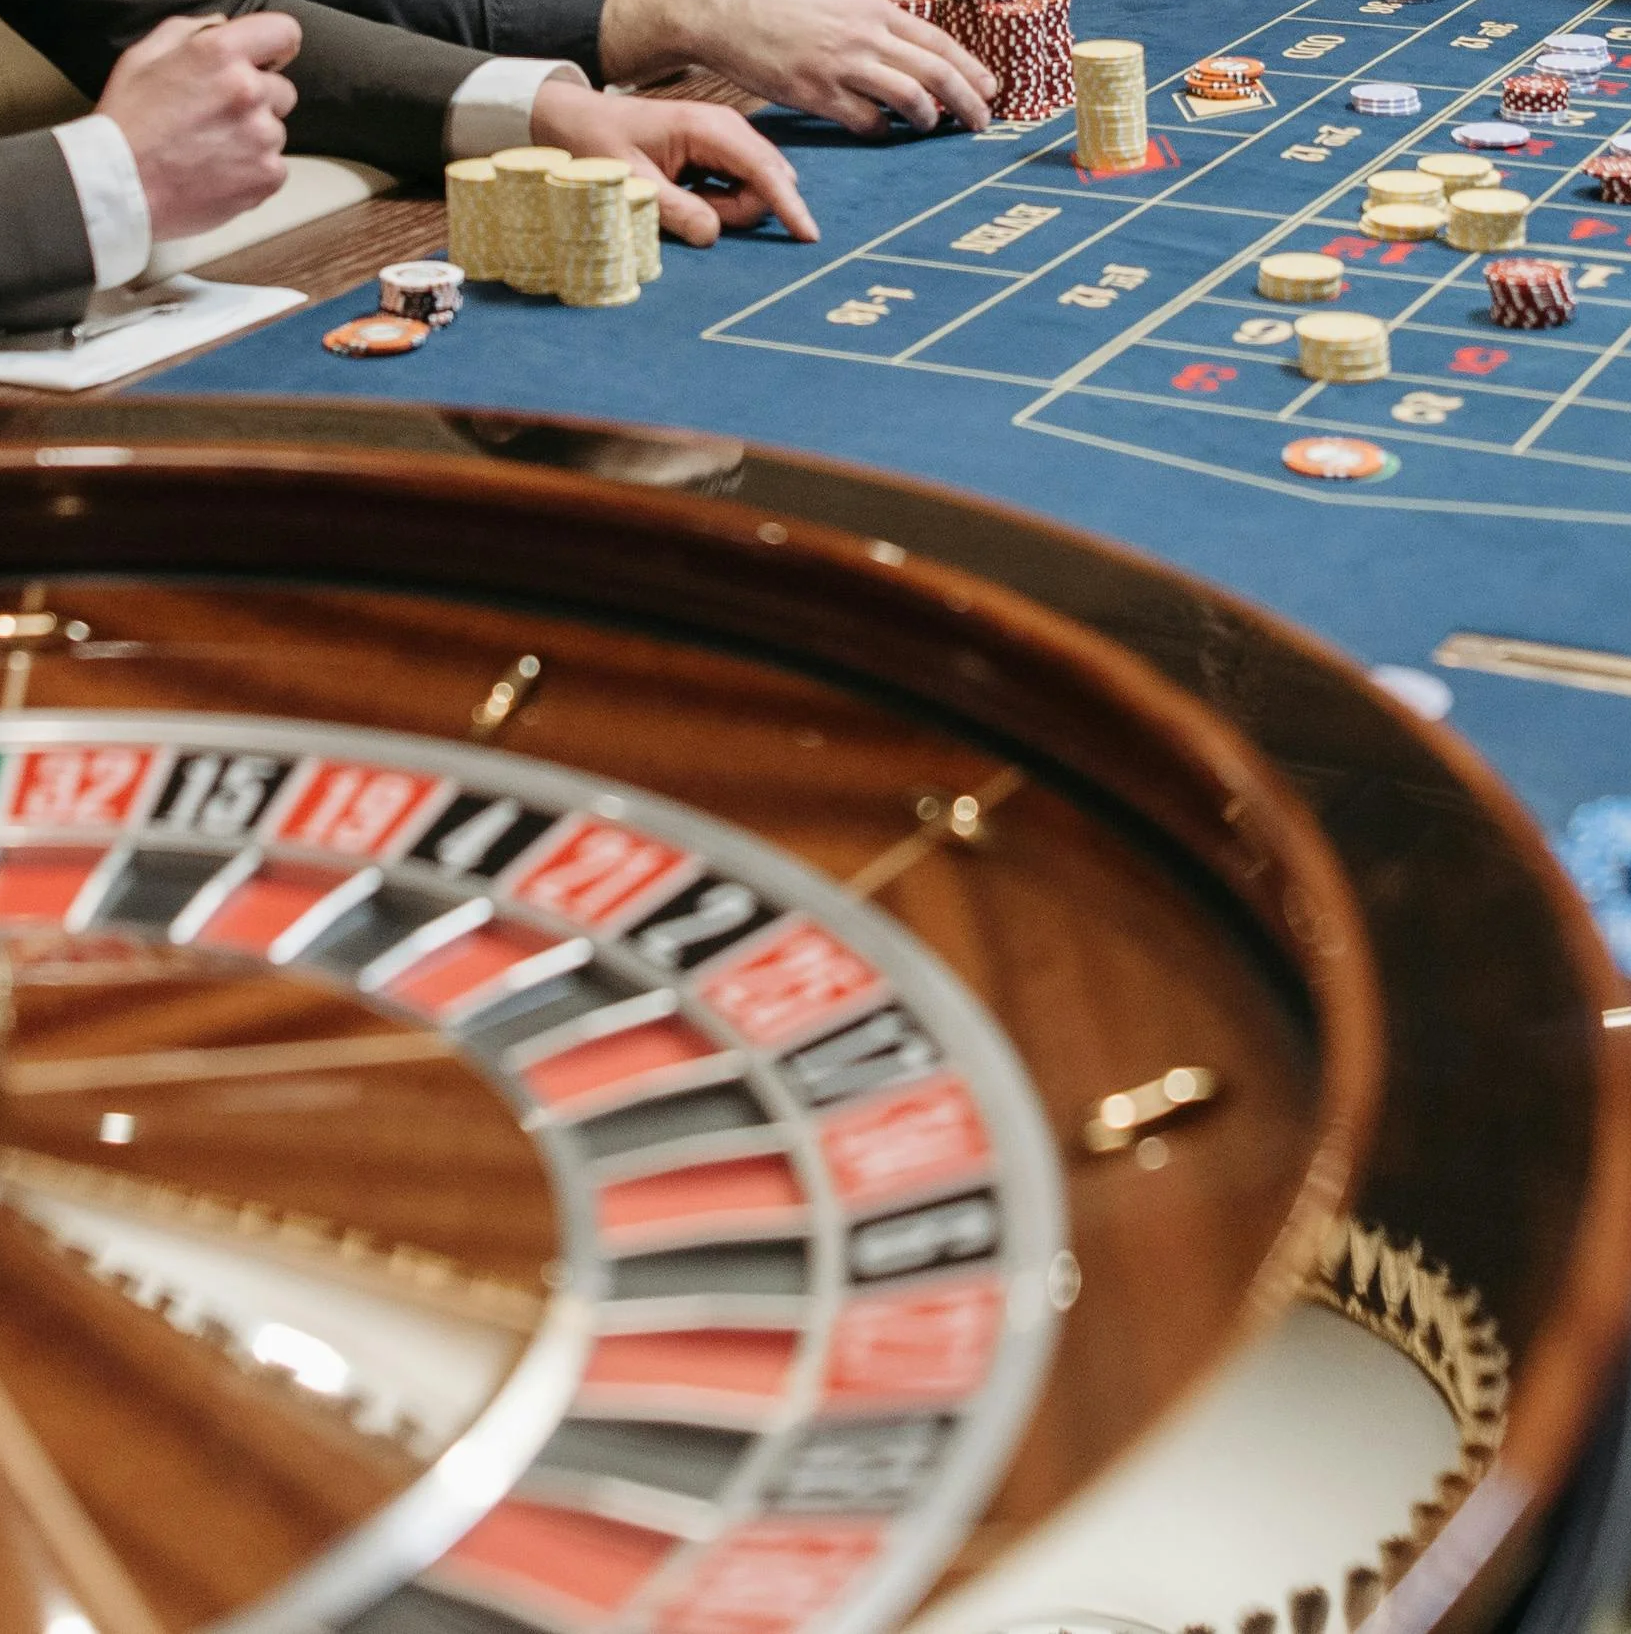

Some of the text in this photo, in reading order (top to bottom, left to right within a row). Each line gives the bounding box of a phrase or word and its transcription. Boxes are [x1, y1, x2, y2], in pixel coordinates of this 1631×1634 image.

[1282, 34, 1346, 59] ODD
[950, 203, 1062, 254] EVEN
[825, 284, 916, 326] 1-18
[1171, 363, 1238, 393] 3
[23, 748, 143, 826] 32
[166, 752, 270, 840] 15
[300, 764, 418, 854] 19
[435, 797, 520, 878] 4
[636, 882, 760, 960] 2
